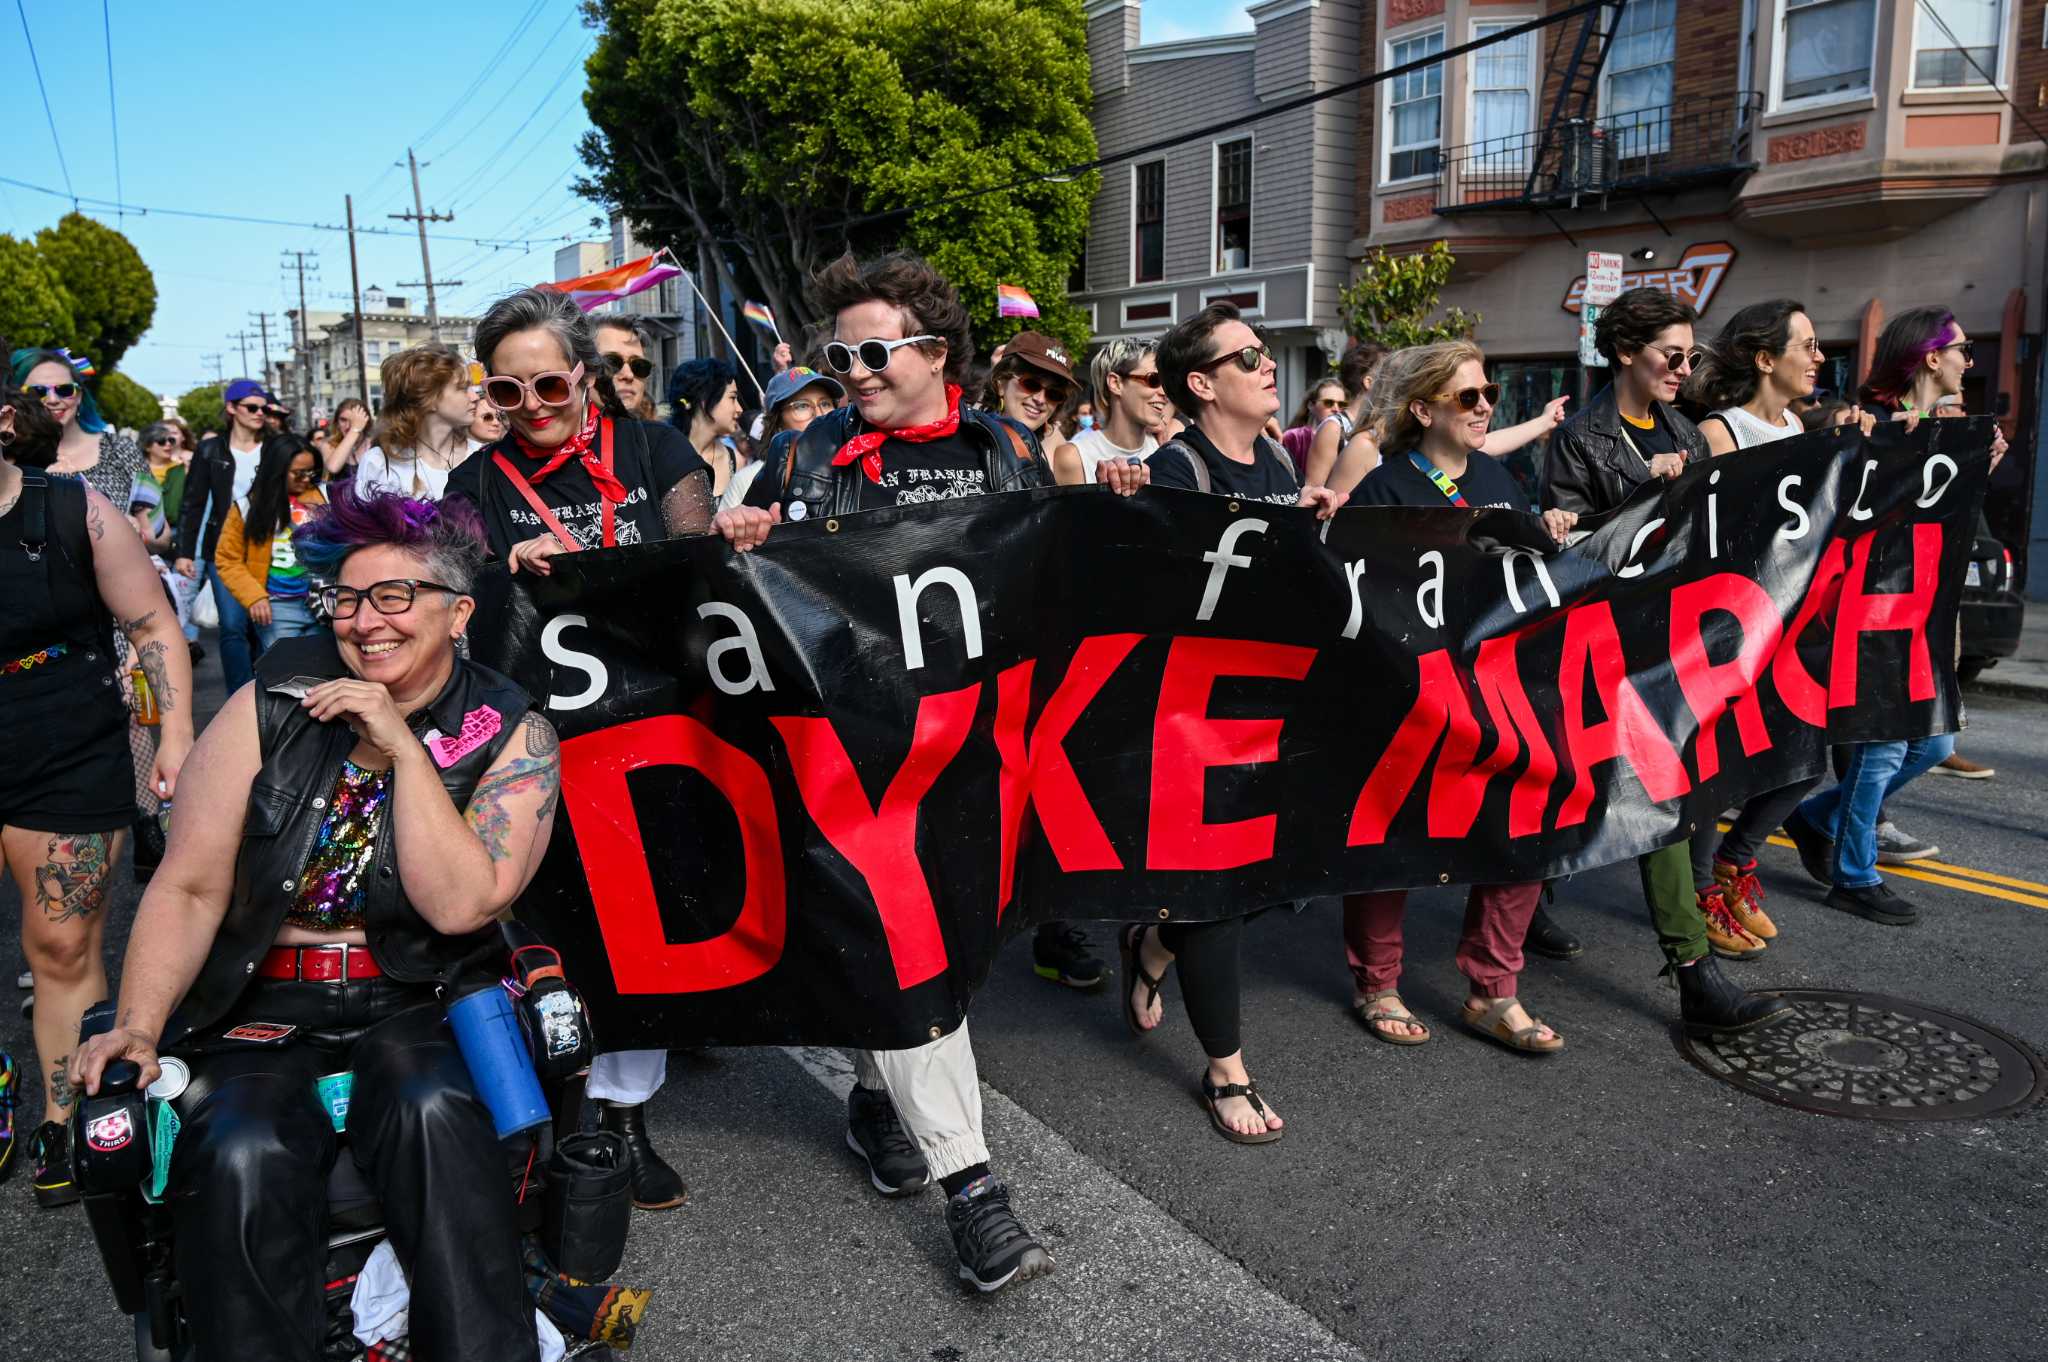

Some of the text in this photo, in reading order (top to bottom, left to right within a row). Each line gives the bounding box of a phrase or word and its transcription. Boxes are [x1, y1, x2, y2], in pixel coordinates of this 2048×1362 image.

[1566, 253, 1731, 313] SPER7
[879, 468, 985, 488] AN FRANCIS
[509, 509, 541, 526] SAN
[539, 453, 1959, 711] san francisco
[560, 522, 1943, 995] DYKE MARCH
[99, 1135, 127, 1148] THIRD
